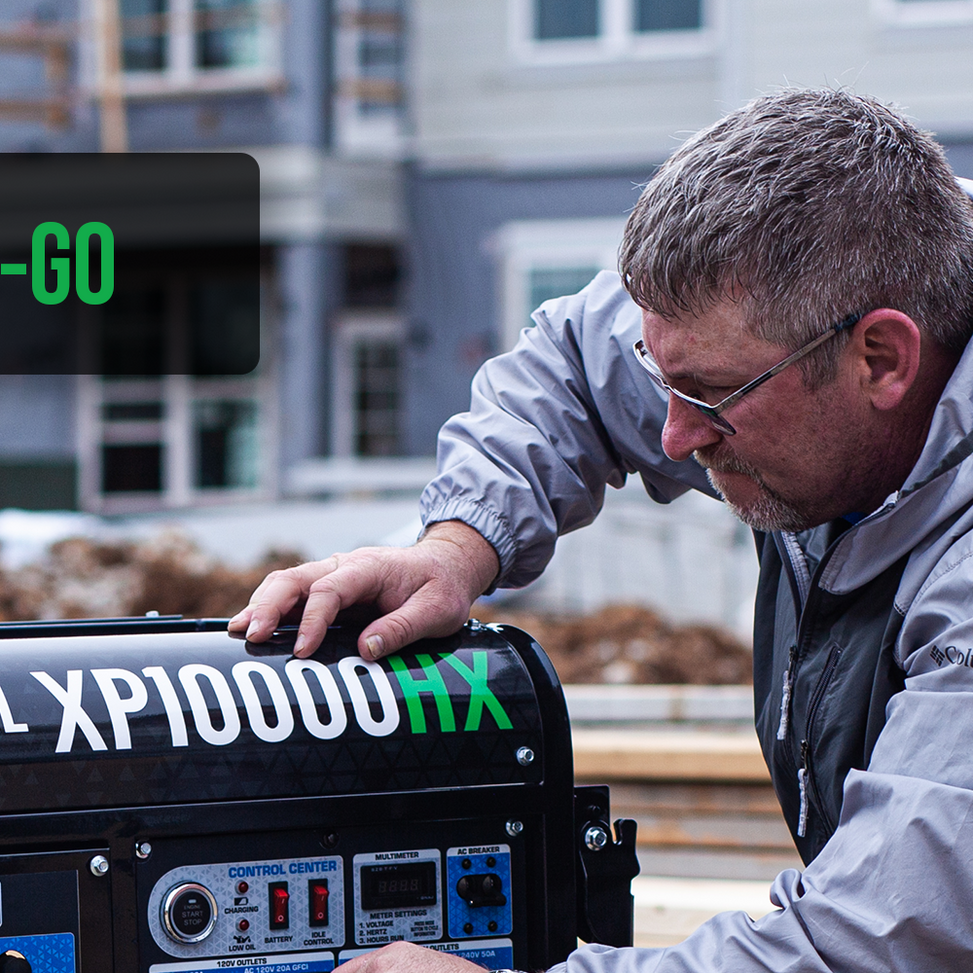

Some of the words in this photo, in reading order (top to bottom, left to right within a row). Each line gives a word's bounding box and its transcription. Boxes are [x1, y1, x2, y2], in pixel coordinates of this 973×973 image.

[29, 650, 514, 754] XP10000HX
[468, 846, 500, 855] BREAKER
[375, 851, 420, 861] MULTIMETER
[228, 864, 286, 879] CONTROL
[288, 860, 337, 874] CENTER
[181, 910, 203, 918] START
[224, 905, 259, 915] CHARGING
[369, 911, 393, 919] METER
[394, 909, 427, 918] SETTINGS
[183, 918, 202, 926] STOP
[366, 920, 394, 928] VOLTAGE
[311, 931, 326, 939] IDLE
[366, 928, 387, 936] HERTZ
[264, 935, 293, 944] BATTERY
[303, 937, 334, 946] CONTROL
[228, 944, 244, 952] LOW
[245, 943, 256, 951] OIL
[217, 959, 236, 967] 120V
[236, 958, 267, 966] OUTLETS
[256, 966, 276, 973] 120V
[276, 965, 291, 973] 20A
[292, 963, 309, 971] GFCI
